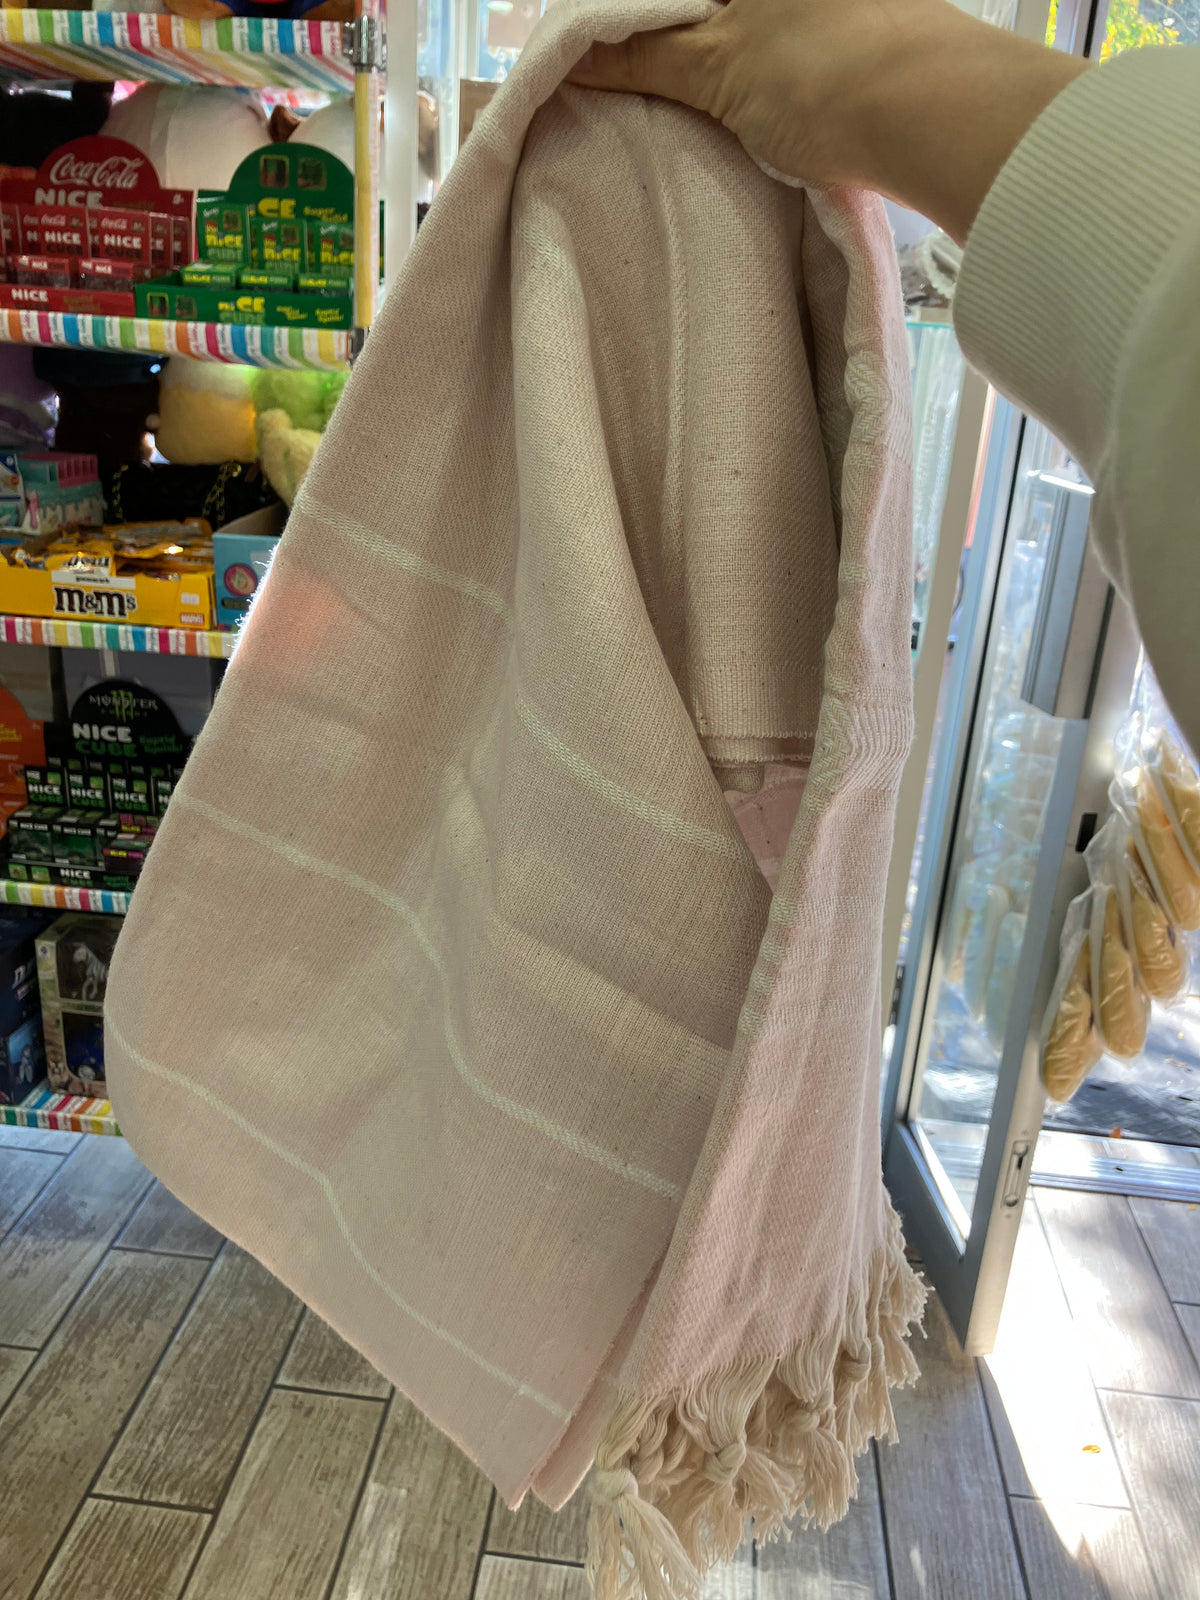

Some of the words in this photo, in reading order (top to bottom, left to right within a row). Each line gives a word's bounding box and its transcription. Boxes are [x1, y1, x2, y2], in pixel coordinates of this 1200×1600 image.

[34, 188, 104, 209] NICE
[44, 230, 81, 245] NICE
[103, 233, 142, 249] NICE
[11, 288, 48, 302] NICE
[72, 722, 133, 743] NICE
[74, 739, 138, 758] CUBE
[28, 783, 62, 796] NICE
[71, 788, 104, 800] NICE
[113, 791, 147, 803] NICE
[60, 868, 91, 880] NICE
